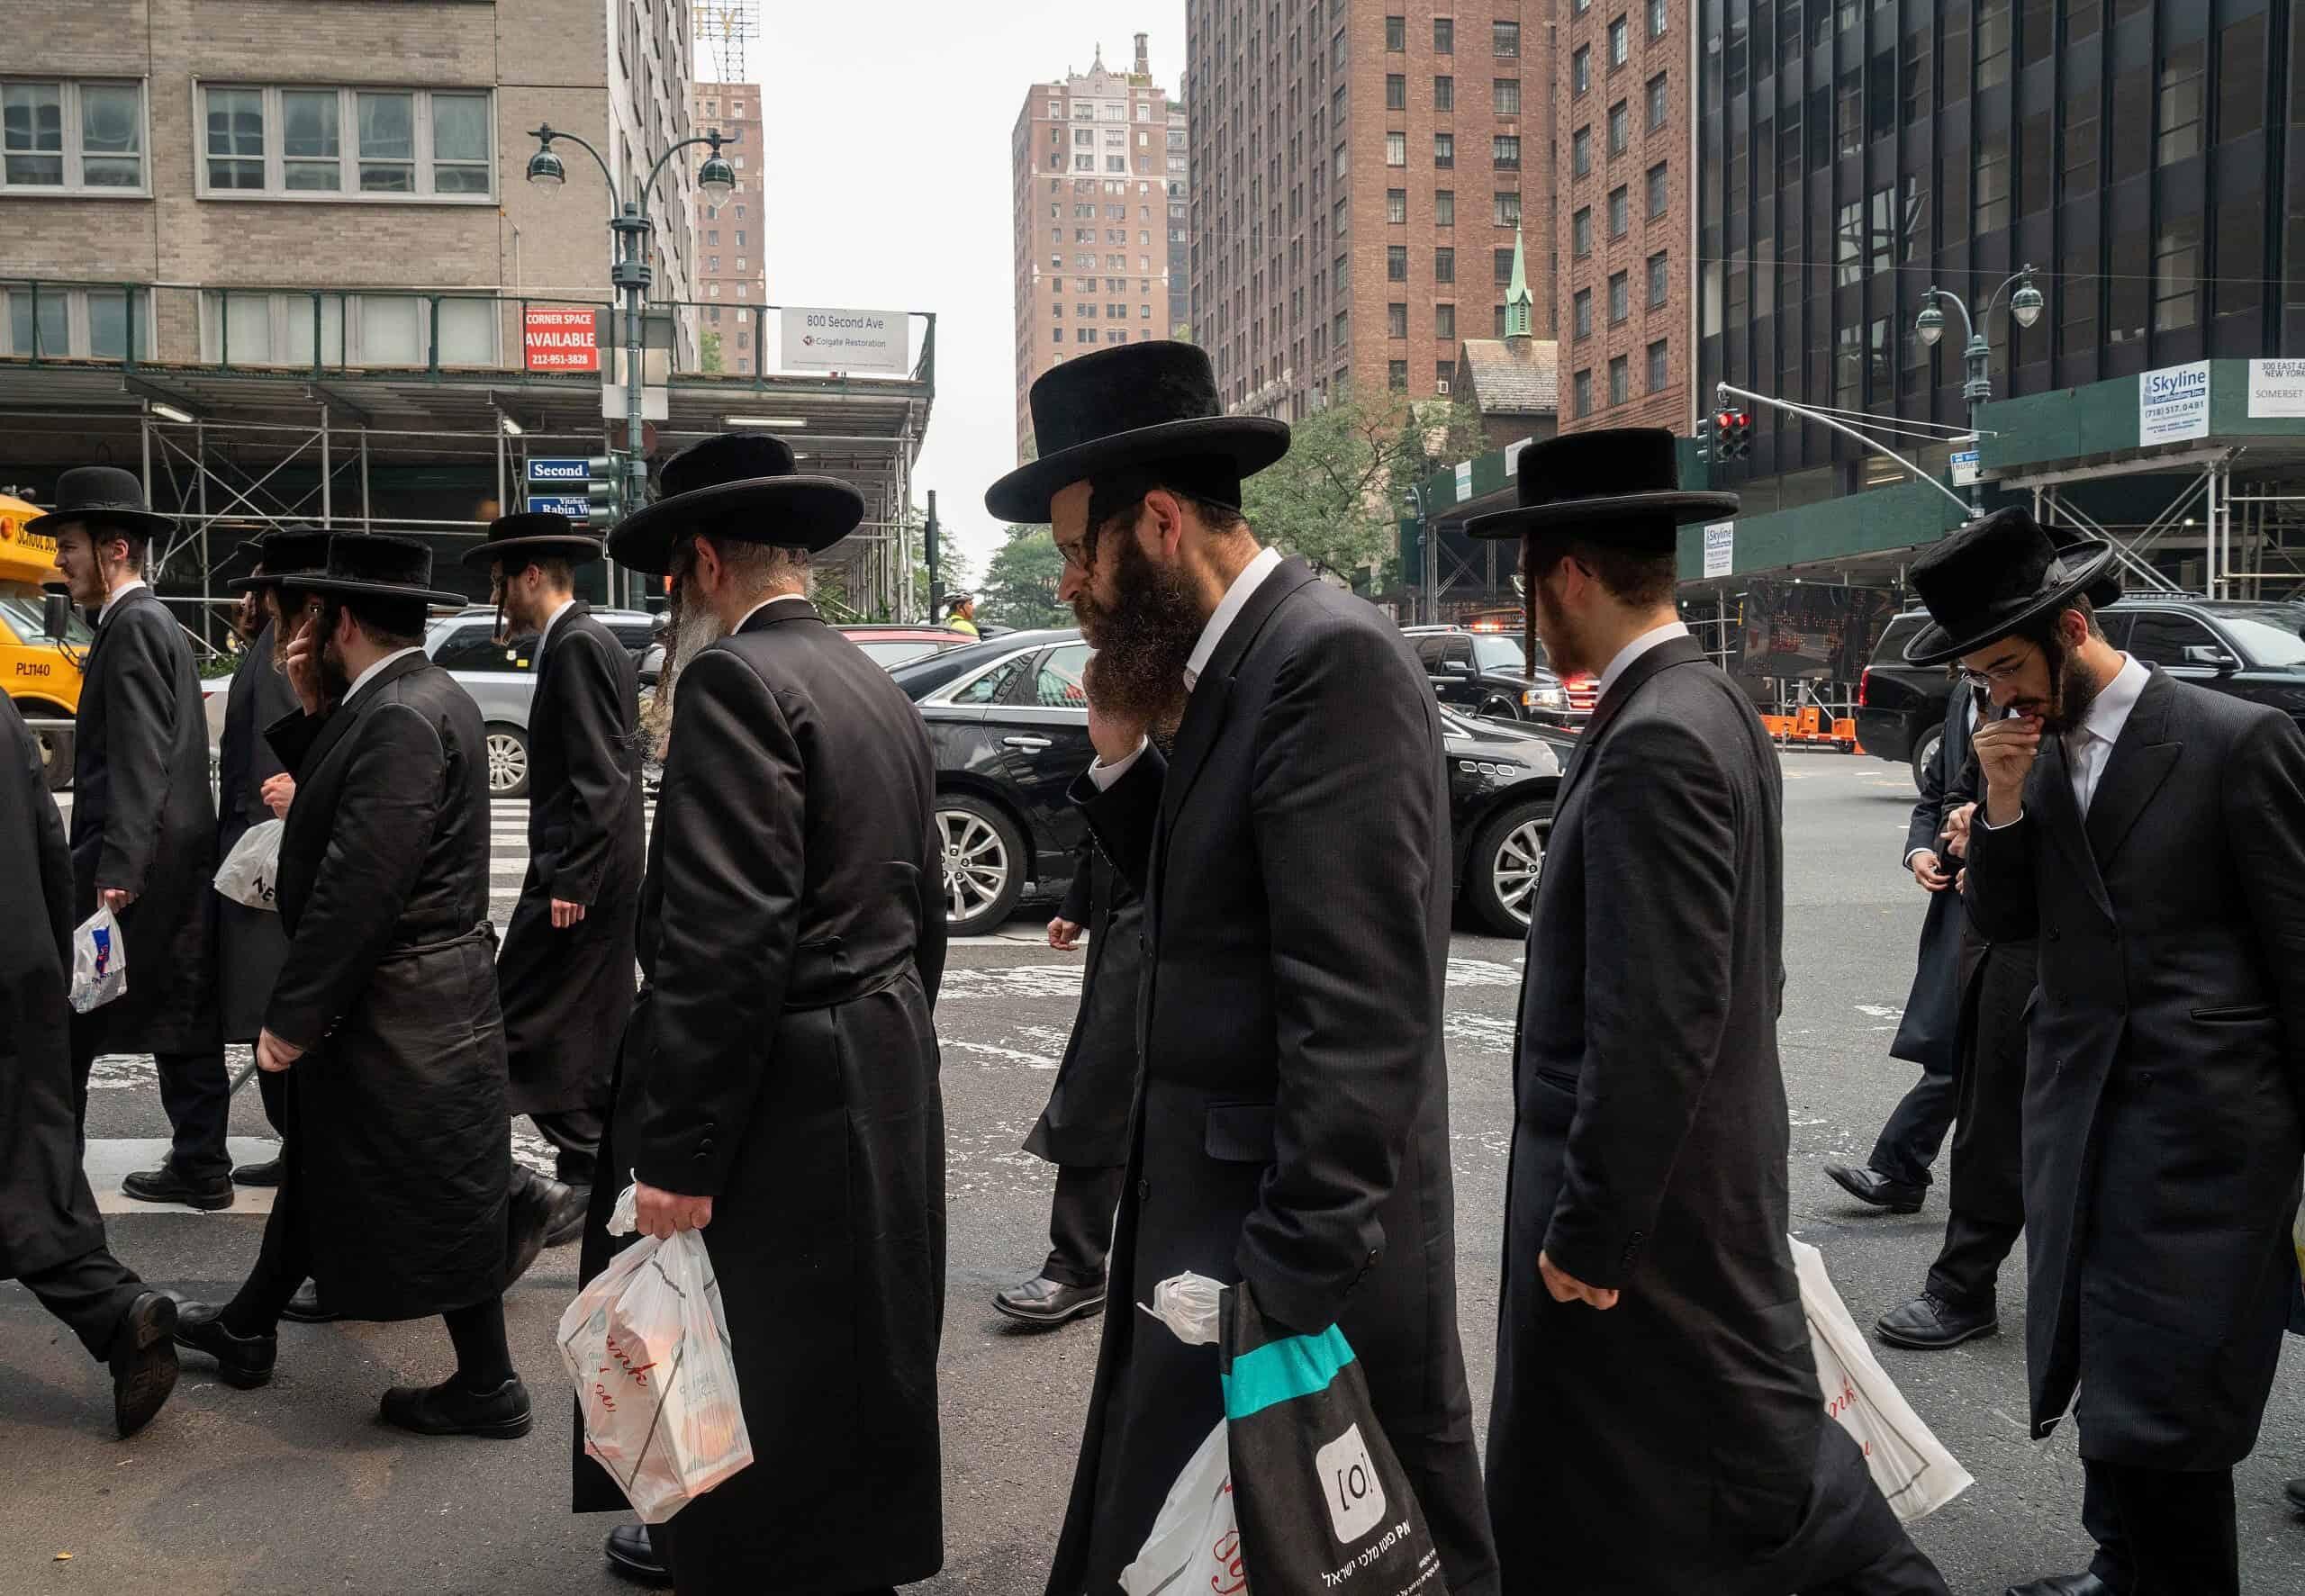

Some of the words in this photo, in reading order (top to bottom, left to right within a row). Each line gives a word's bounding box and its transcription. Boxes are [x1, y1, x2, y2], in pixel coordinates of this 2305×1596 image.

[526, 314, 563, 324] CORNER
[565, 314, 592, 324] SPACE
[807, 315, 826, 327] 800
[828, 316, 863, 329] Second
[865, 317, 884, 329] Ave
[526, 332, 594, 347] AVAILABLE
[845, 338, 886, 348] Restoration
[532, 354, 589, 364] 212-951-3828
[2277, 362, 2295, 370] EAST
[2153, 371, 2206, 395] Skyline
[2255, 390, 2303, 398] SOMERSET
[535, 464, 583, 476] Second
[542, 504, 576, 515] Rabin
[15, 663, 50, 676] PL1140
[1321, 1560, 1357, 1588] ישראל
